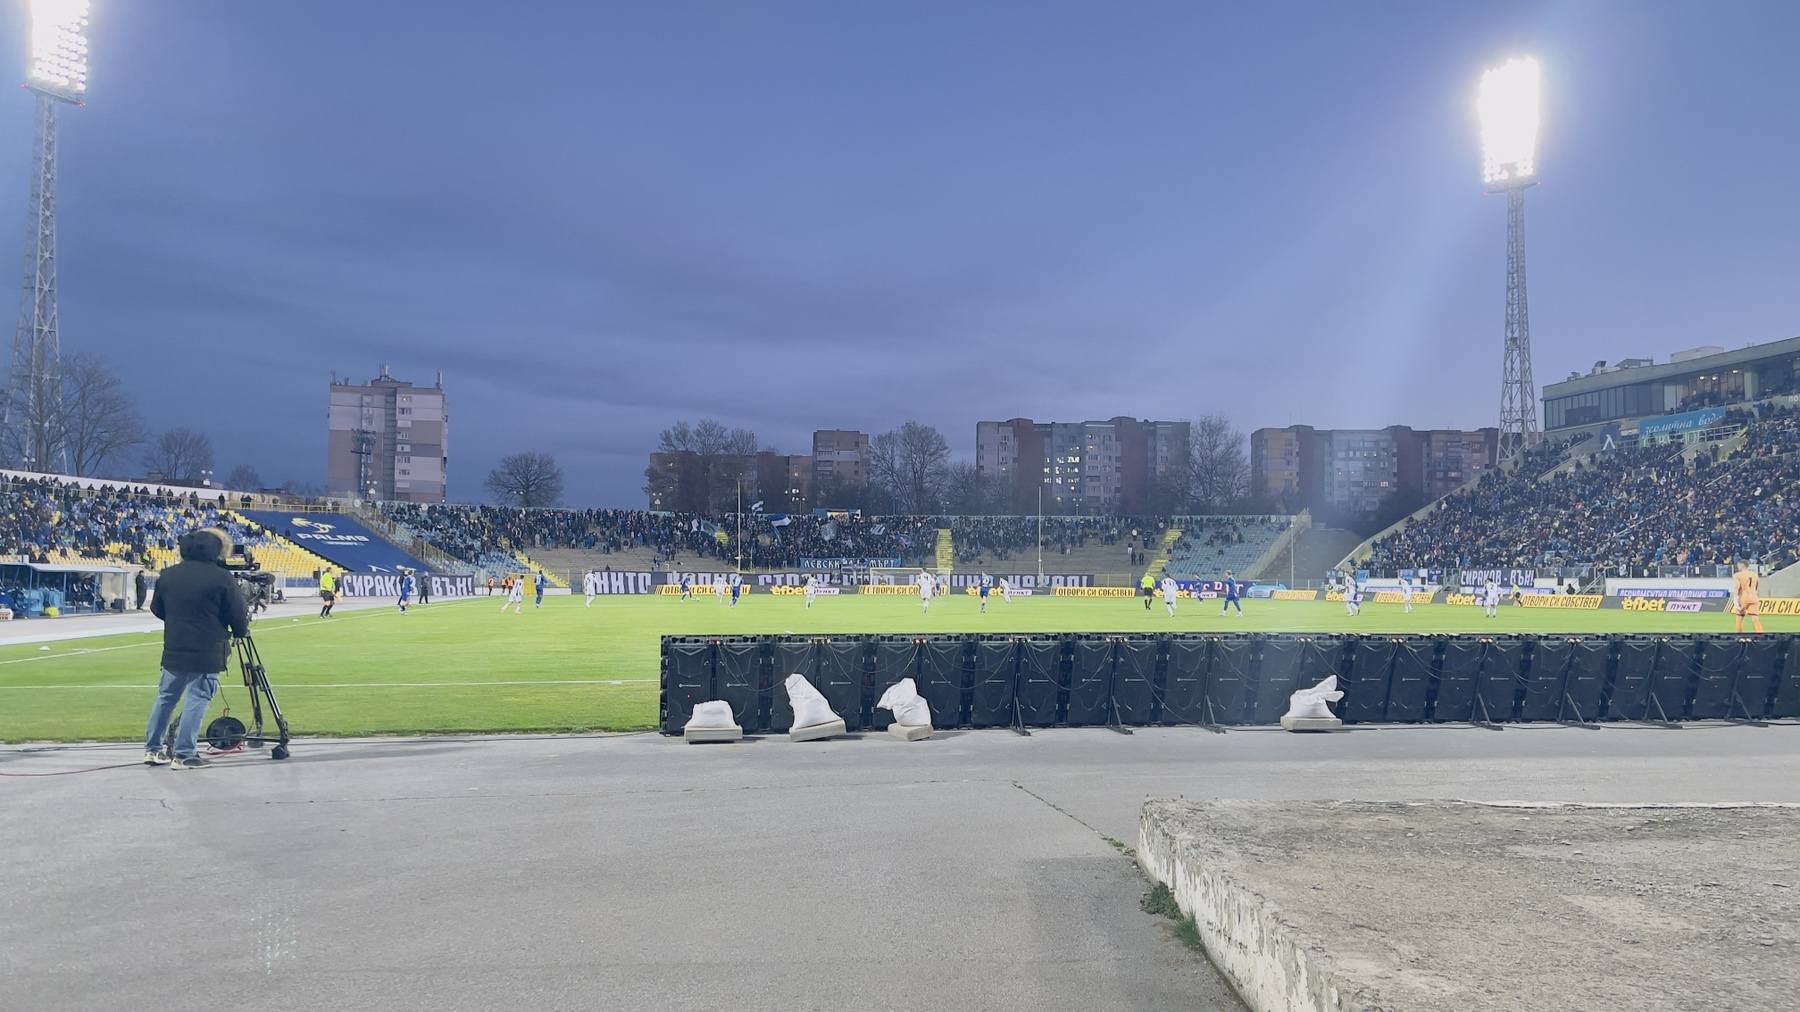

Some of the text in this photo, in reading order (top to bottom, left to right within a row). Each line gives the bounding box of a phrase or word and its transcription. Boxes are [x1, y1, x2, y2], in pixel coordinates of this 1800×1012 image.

[296, 533, 369, 542] PALMS
[595, 572, 652, 594] НИТО
[1460, 570, 1502, 585] СИРАКОВ
[1510, 570, 1534, 585] ВЪН!
[343, 575, 474, 597] СИРАКВ ВЪН!
[1549, 597, 1559, 608] СИ
[1560, 597, 1599, 609] СОБСТВЕН
[1623, 597, 1665, 611] efbet
[1669, 603, 1697, 611] ПУНКТ
[1777, 600, 1793, 613] СИ
